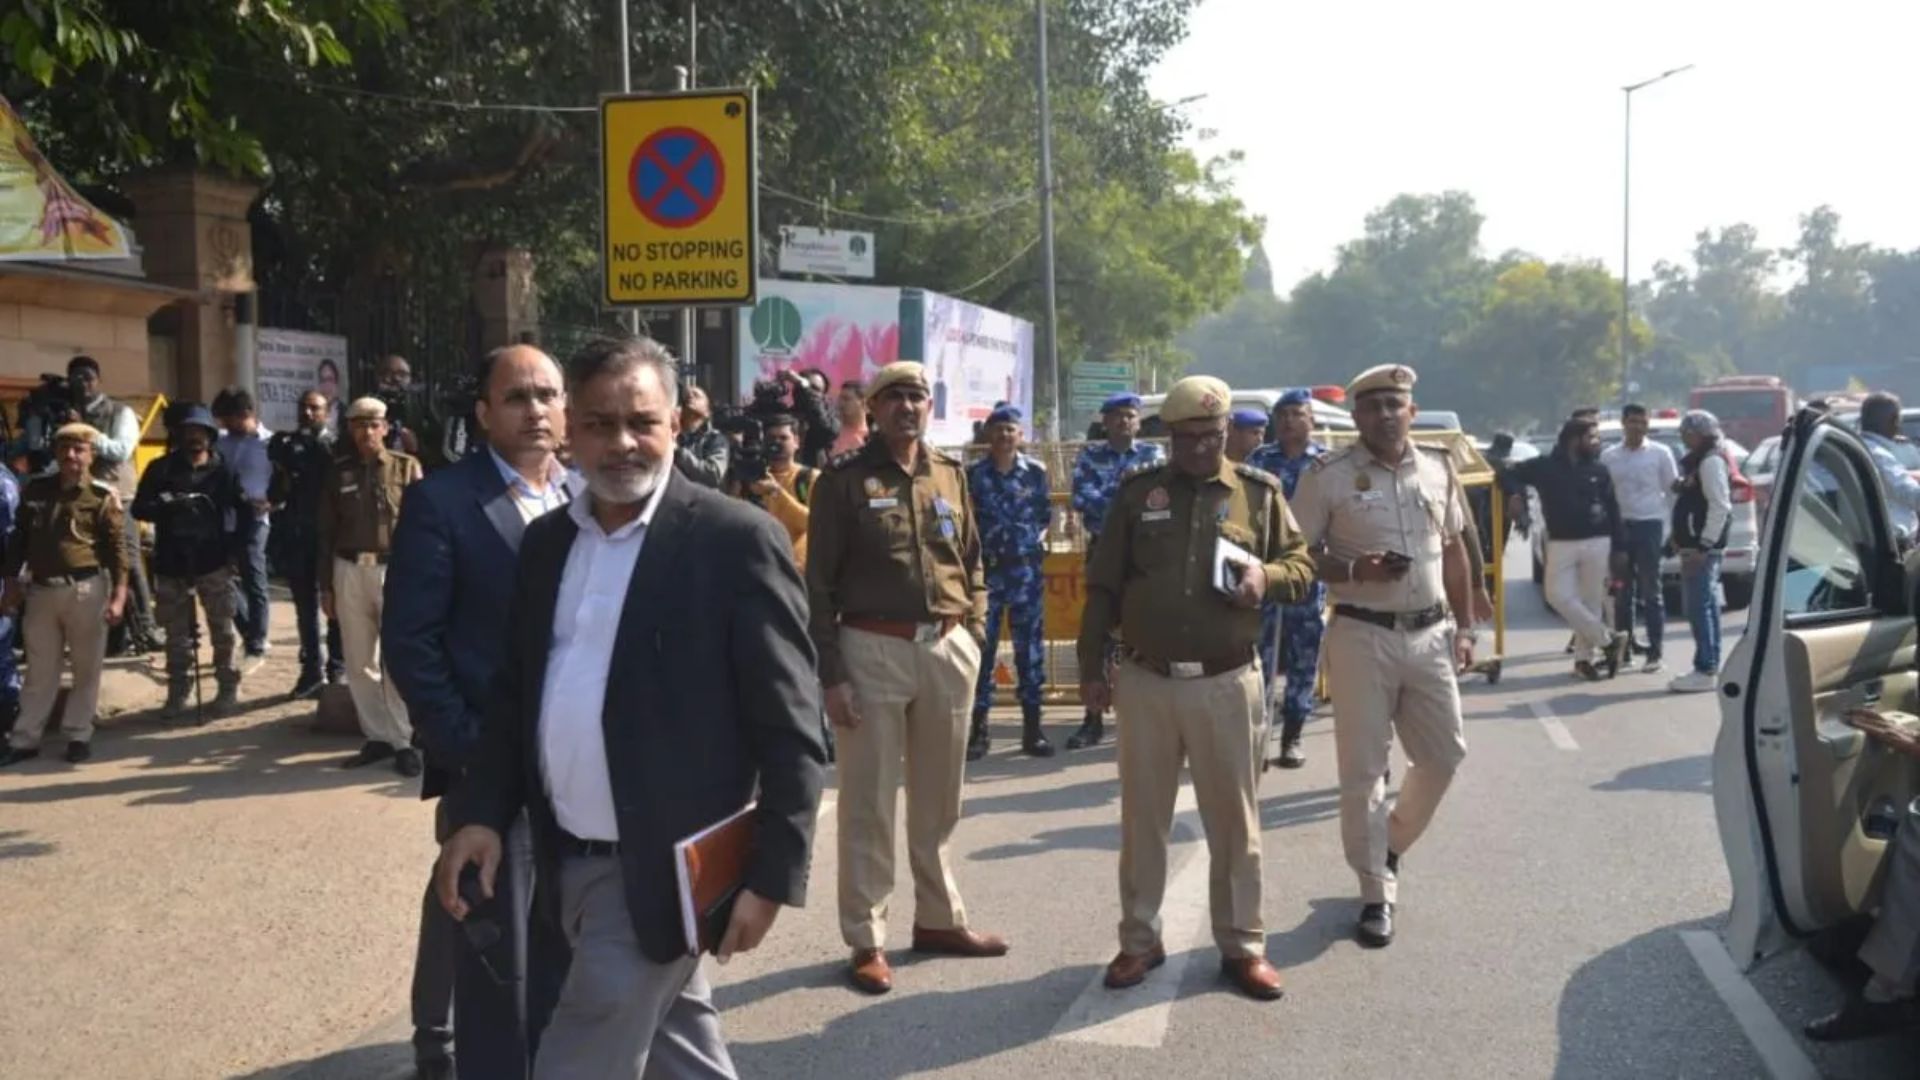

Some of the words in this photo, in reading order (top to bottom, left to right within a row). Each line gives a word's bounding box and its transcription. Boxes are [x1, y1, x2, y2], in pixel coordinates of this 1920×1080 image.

[614, 243, 641, 261] NO
[646, 240, 743, 260] STOPPING
[619, 272, 646, 290] NO
[653, 269, 738, 289] PARKING
